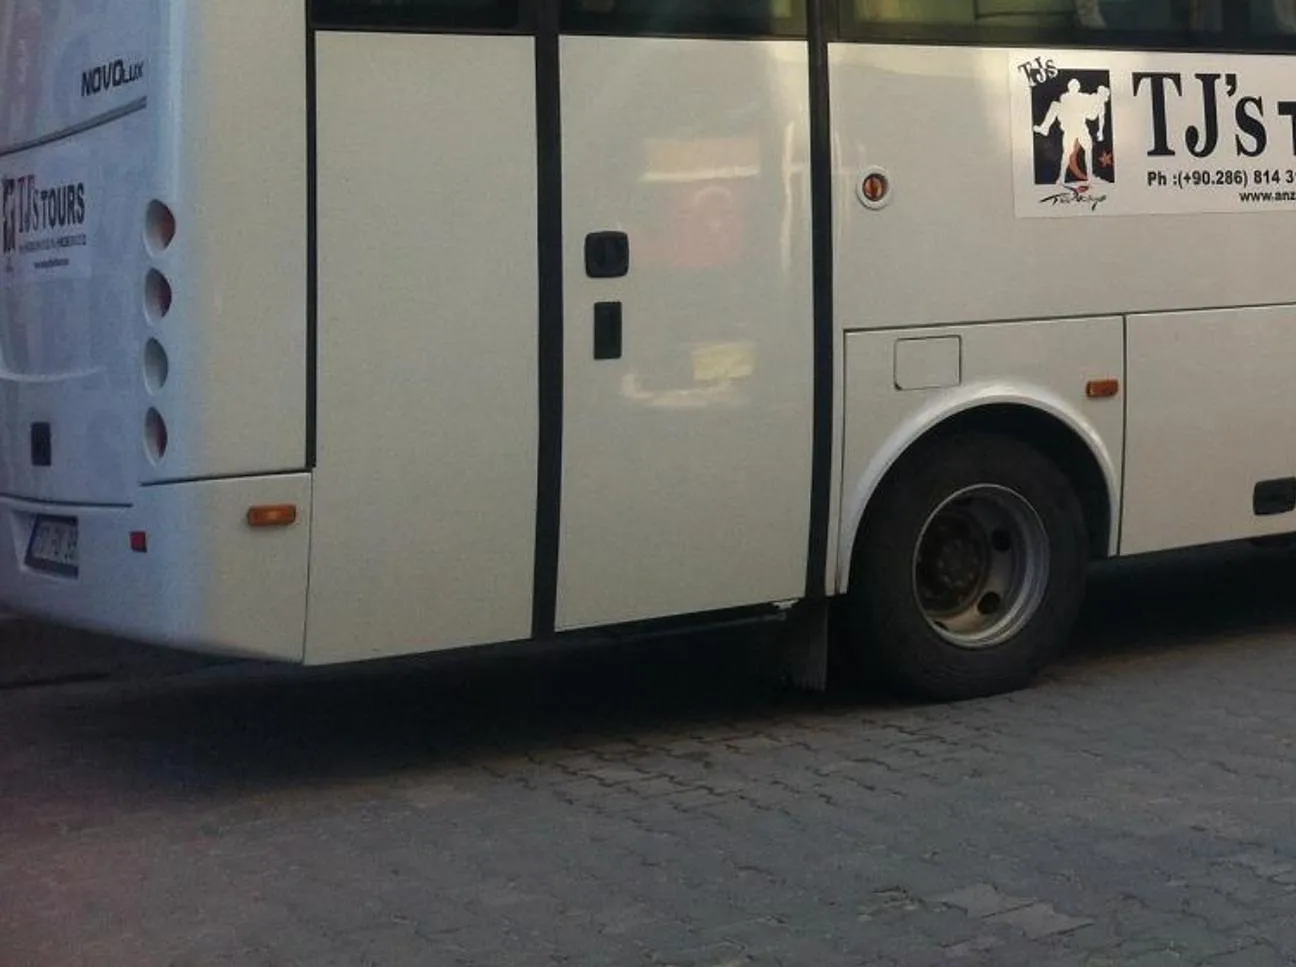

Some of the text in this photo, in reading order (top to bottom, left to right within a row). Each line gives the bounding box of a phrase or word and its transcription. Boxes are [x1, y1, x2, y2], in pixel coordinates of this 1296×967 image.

[1131, 72, 1268, 158] TJ's
[1147, 171, 1168, 186] Ph
[1253, 170, 1281, 184] 814
[40, 182, 86, 230] TOURS
